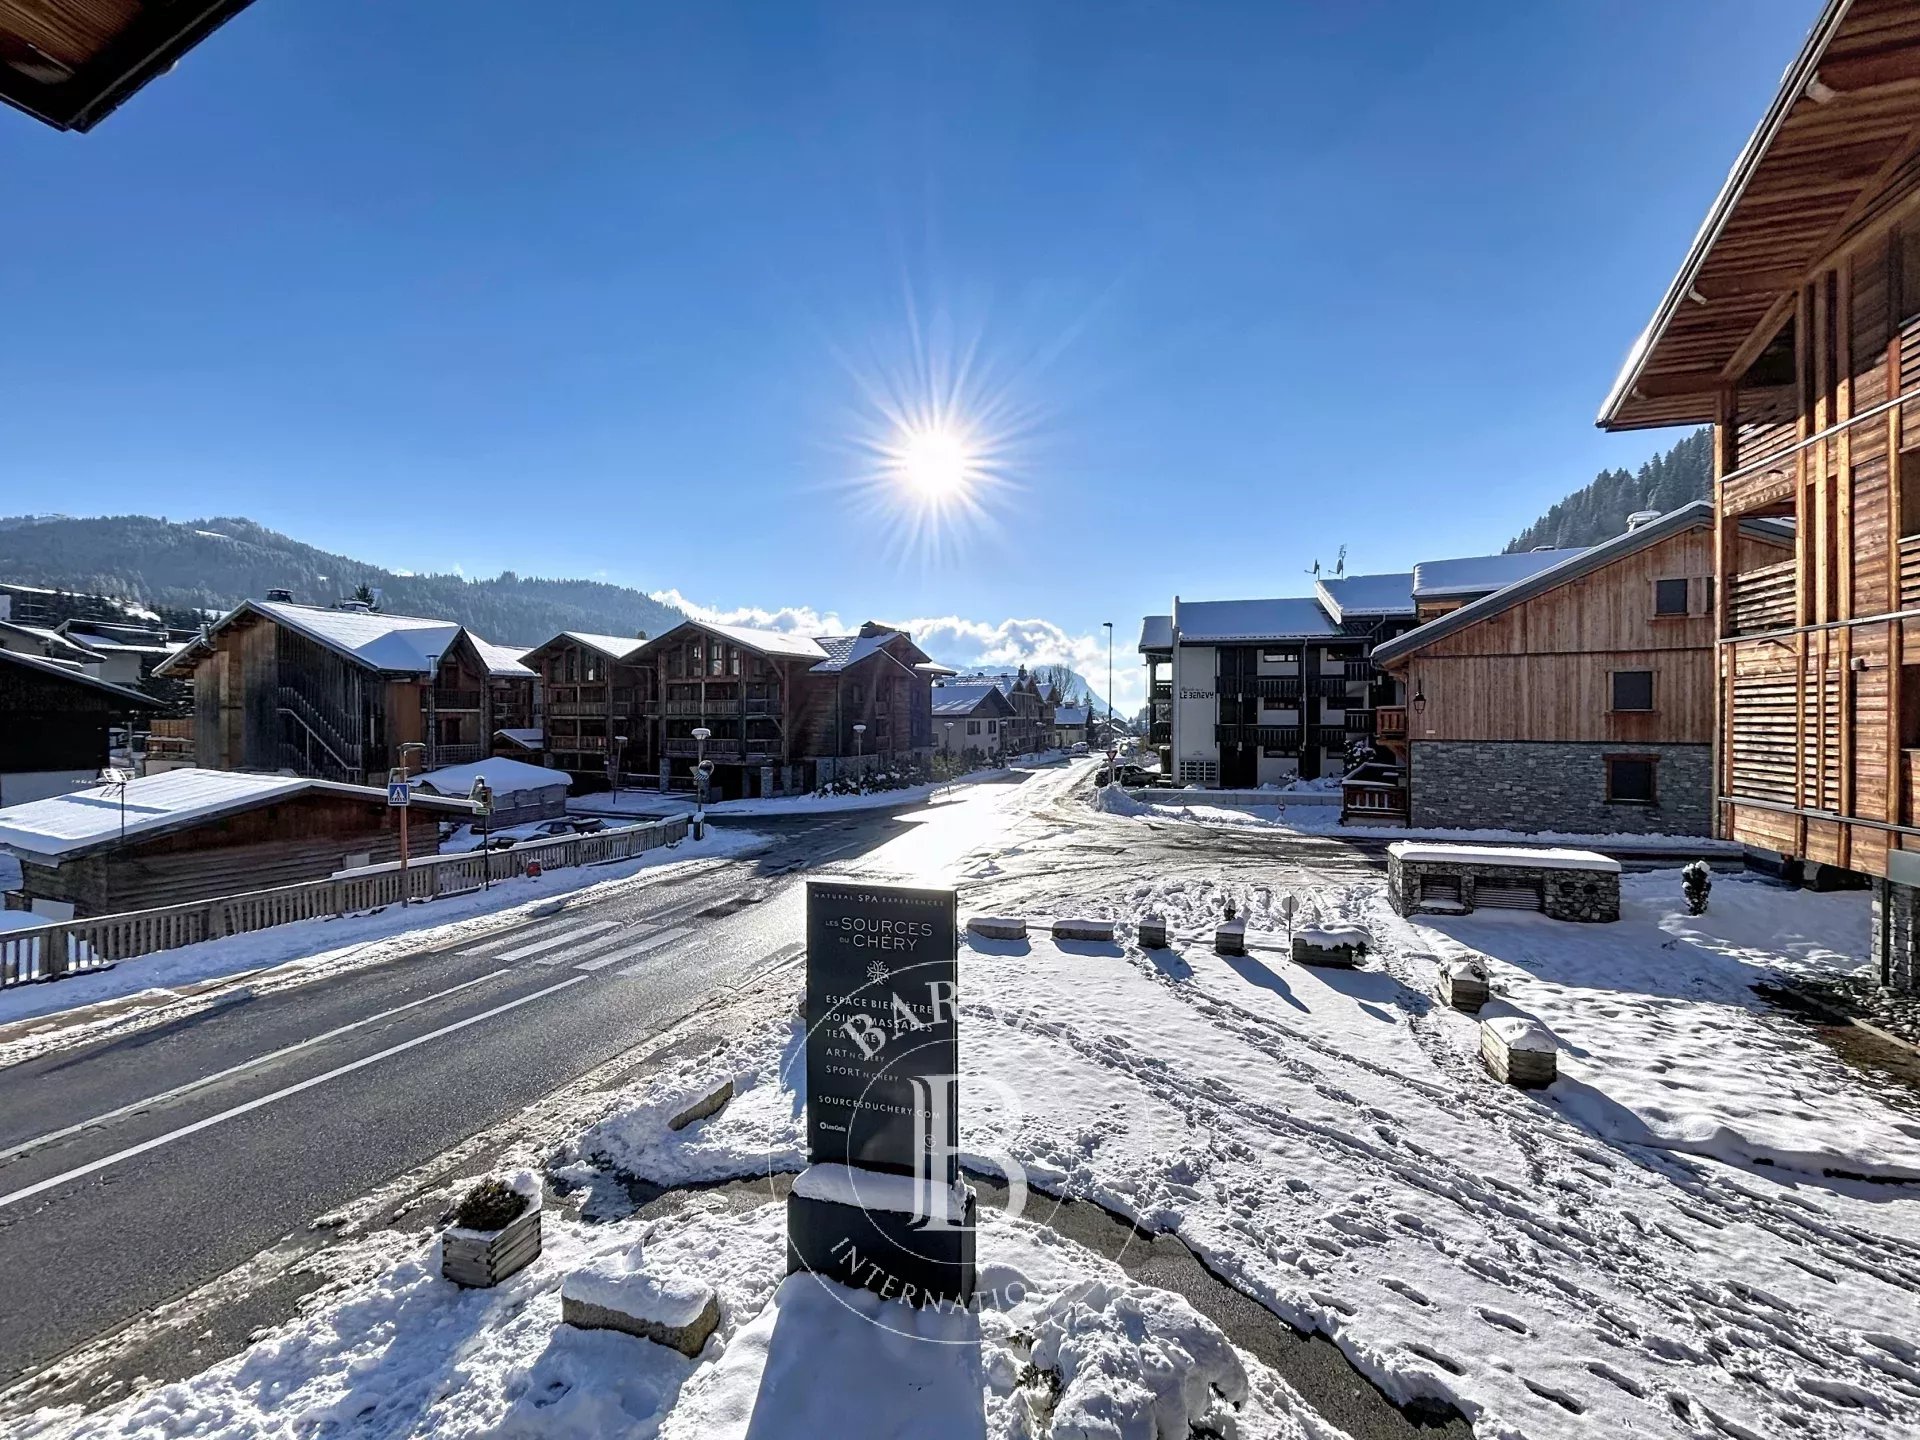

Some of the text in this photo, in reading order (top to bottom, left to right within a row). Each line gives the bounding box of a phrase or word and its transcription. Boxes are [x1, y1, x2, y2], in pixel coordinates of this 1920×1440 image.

[858, 894, 878, 903] SPA
[841, 917, 933, 937] SOURCES
[853, 934, 918, 951] CHÉRY
[826, 994, 867, 1007] ESPACE
[825, 1013, 933, 1033] SOINS MASSAGES
[826, 1029, 846, 1039] TEA
[826, 1048, 848, 1058] ART
[826, 1065, 860, 1077] SPORT
[818, 1095, 940, 1120] SOURCESDUCHERY.COM
